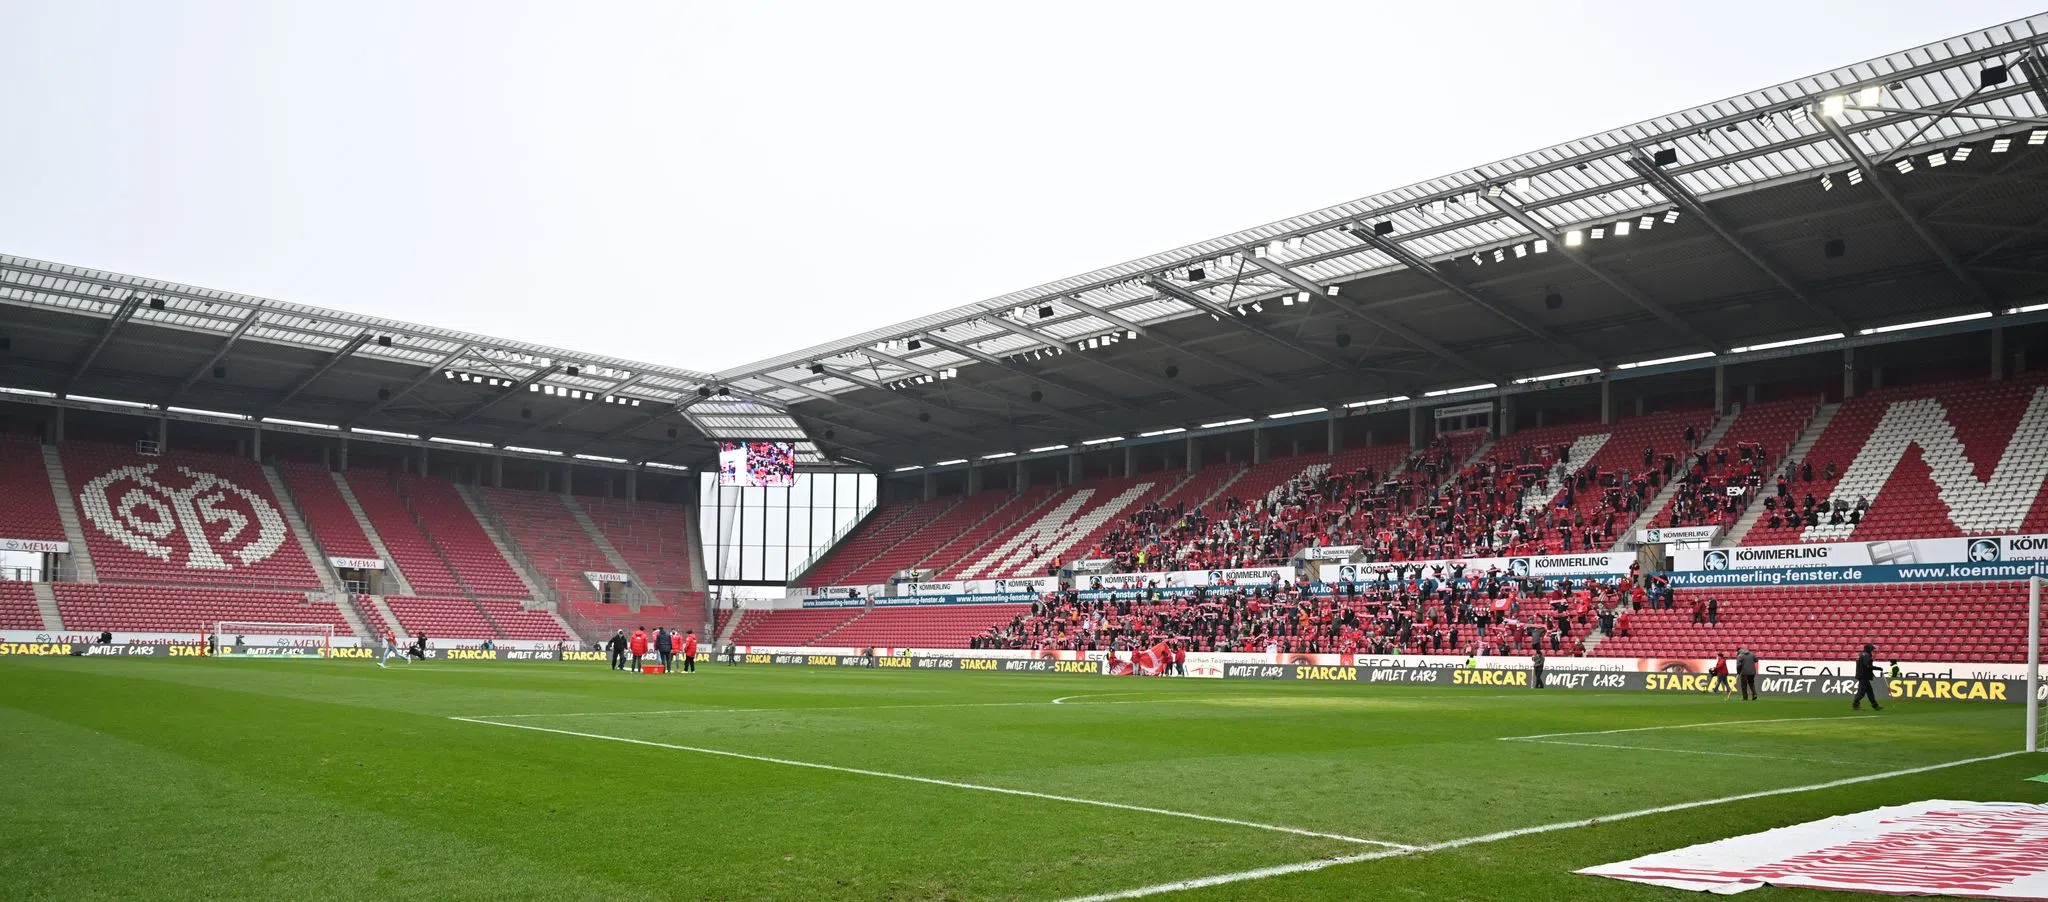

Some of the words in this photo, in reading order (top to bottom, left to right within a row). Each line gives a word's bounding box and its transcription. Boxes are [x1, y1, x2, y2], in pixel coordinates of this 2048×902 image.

[1663, 530, 1709, 538] KÖMMERLING
[22, 542, 58, 551] MEWA
[2010, 536, 2048, 550] KÖM
[1736, 547, 1828, 560] KÖMMERLING
[348, 560, 377, 568] MEWA
[1535, 556, 1609, 568] KÖMMERLING
[1666, 568, 1862, 585] w.koemmerling-fenster.de
[1899, 562, 2048, 578] www.koemmerli
[956, 594, 1039, 603] www.koemmerling-fenster.de
[0, 643, 72, 655] STARCAR
[88, 645, 126, 655] OUTLET
[128, 645, 154, 655] CARS
[447, 649, 497, 660] STARCAR
[507, 651, 533, 660] OUTLET
[534, 651, 553, 660] CARS
[562, 651, 607, 661] STARCAR
[745, 655, 771, 664] STARCAR
[808, 656, 837, 665] STARCAR
[879, 657, 912, 668] STARCAR
[960, 660, 997, 670] STARCAR
[1006, 661, 1028, 670] OUTLET
[1054, 662, 1098, 673] STARCAR
[1229, 665, 1259, 676] OUTLET
[1260, 666, 1284, 677] CARS
[1296, 666, 1357, 681] STARCAR
[1371, 669, 1407, 682] OUTLET
[1410, 670, 1438, 682] CARS
[1452, 670, 1527, 686] STARCAR
[1545, 672, 1589, 687] OUTLET
[1592, 674, 1626, 688] CARS
[1761, 677, 1816, 694] OUTLET
[1889, 680, 2007, 700] STARCAR
